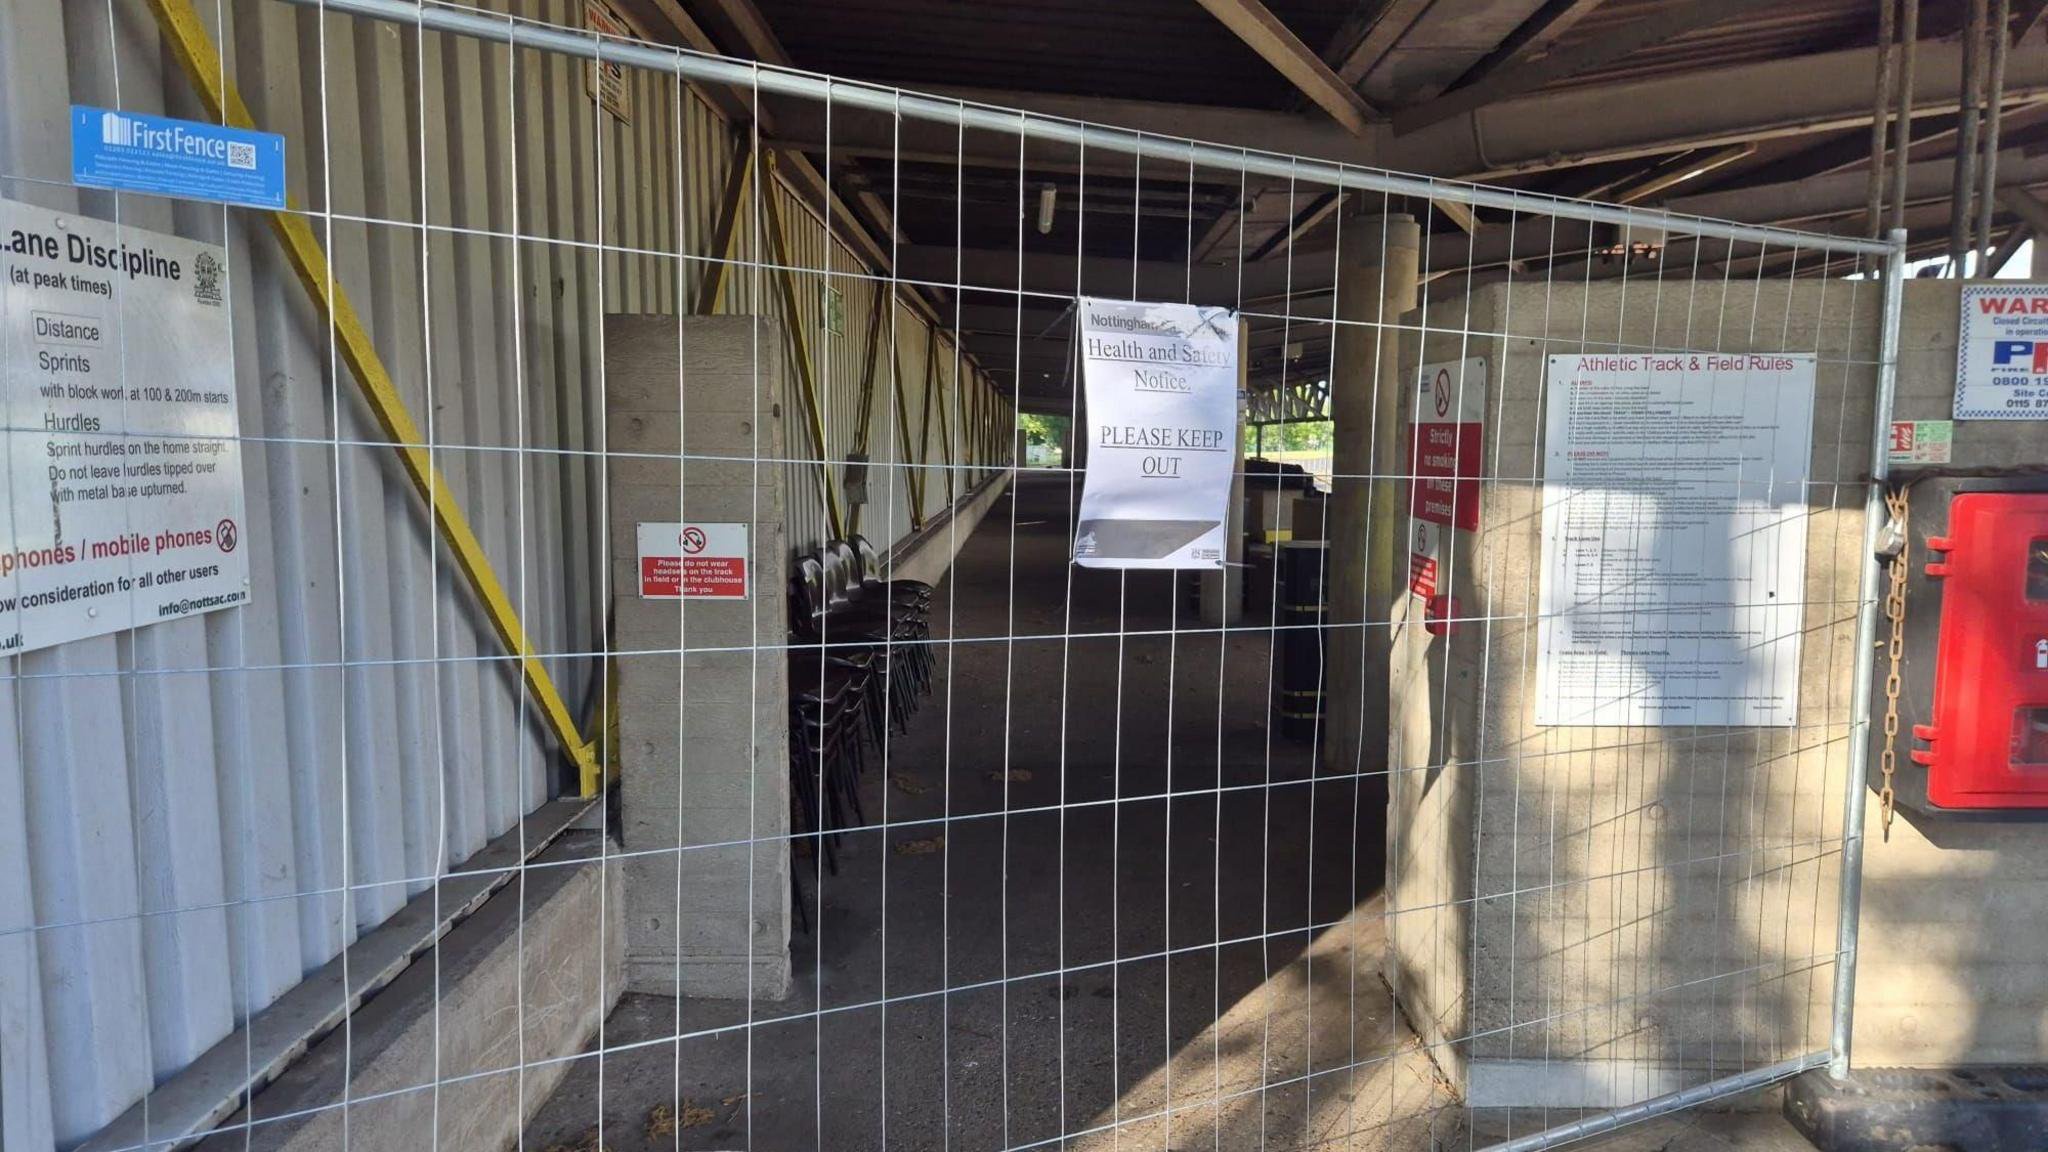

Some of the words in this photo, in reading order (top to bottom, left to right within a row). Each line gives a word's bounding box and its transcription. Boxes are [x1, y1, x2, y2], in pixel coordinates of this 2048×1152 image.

[133, 121, 225, 159] FirstFence
[0, 230, 59, 260] ane
[67, 233, 181, 280] Discipline
[10, 264, 29, 286] (at
[34, 272, 67, 289] peak
[71, 275, 112, 299] times)
[36, 317, 99, 341] Distance
[1088, 339, 1142, 359] Health
[1149, 343, 1177, 361] and
[1183, 344, 1231, 364] Safety
[39, 350, 90, 374] Sprints
[1577, 356, 1637, 371] Athletic
[1642, 356, 1682, 371] Track
[1689, 356, 1700, 371] &
[1707, 356, 1743, 371] Field
[1750, 356, 1794, 371] Rules
[1134, 370, 1192, 391] Notice.
[1993, 377, 2029, 385] 0800
[40, 384, 65, 398] with
[68, 384, 98, 399] block
[130, 388, 140, 400] at
[144, 388, 161, 402] 100
[165, 388, 172, 402] &
[175, 388, 201, 402] 200m
[204, 392, 229, 404] starts
[2014, 389, 2035, 397] Site
[2006, 400, 2030, 408] 0115
[44, 413, 100, 431] Hurdles
[1101, 425, 1171, 446] PLEASE
[1178, 429, 1223, 449] KEEP
[1430, 428, 1453, 447] Strictly
[47, 441, 81, 460] Sprint
[84, 440, 125, 456] hurdles
[128, 443, 141, 454] on
[144, 441, 160, 455] the
[162, 440, 189, 454] home
[49, 466, 66, 481] Do
[70, 466, 87, 480] not
[90, 464, 120, 479] leave
[123, 463, 161, 477] hurdles
[164, 462, 193, 477] tipped
[196, 462, 216, 472] over
[1142, 457, 1182, 475] OUT
[1424, 455, 1432, 466] no
[1432, 452, 1457, 471] smoking
[50, 487, 74, 503] with
[78, 485, 108, 500] metal
[140, 481, 187, 501] upturned.
[0, 545, 76, 578] phones
[81, 538, 86, 560] /
[92, 532, 150, 559] mobile
[156, 527, 212, 555] phones
[21, 578, 114, 609] consideration
[118, 576, 135, 592] for
[139, 572, 152, 588] all
[156, 569, 187, 585] other
[189, 564, 219, 580] users
[653, 575, 669, 583] field
[704, 576, 742, 584] clubhouse
[700, 586, 713, 594] you
[159, 590, 246, 616] info@nottsac.com
